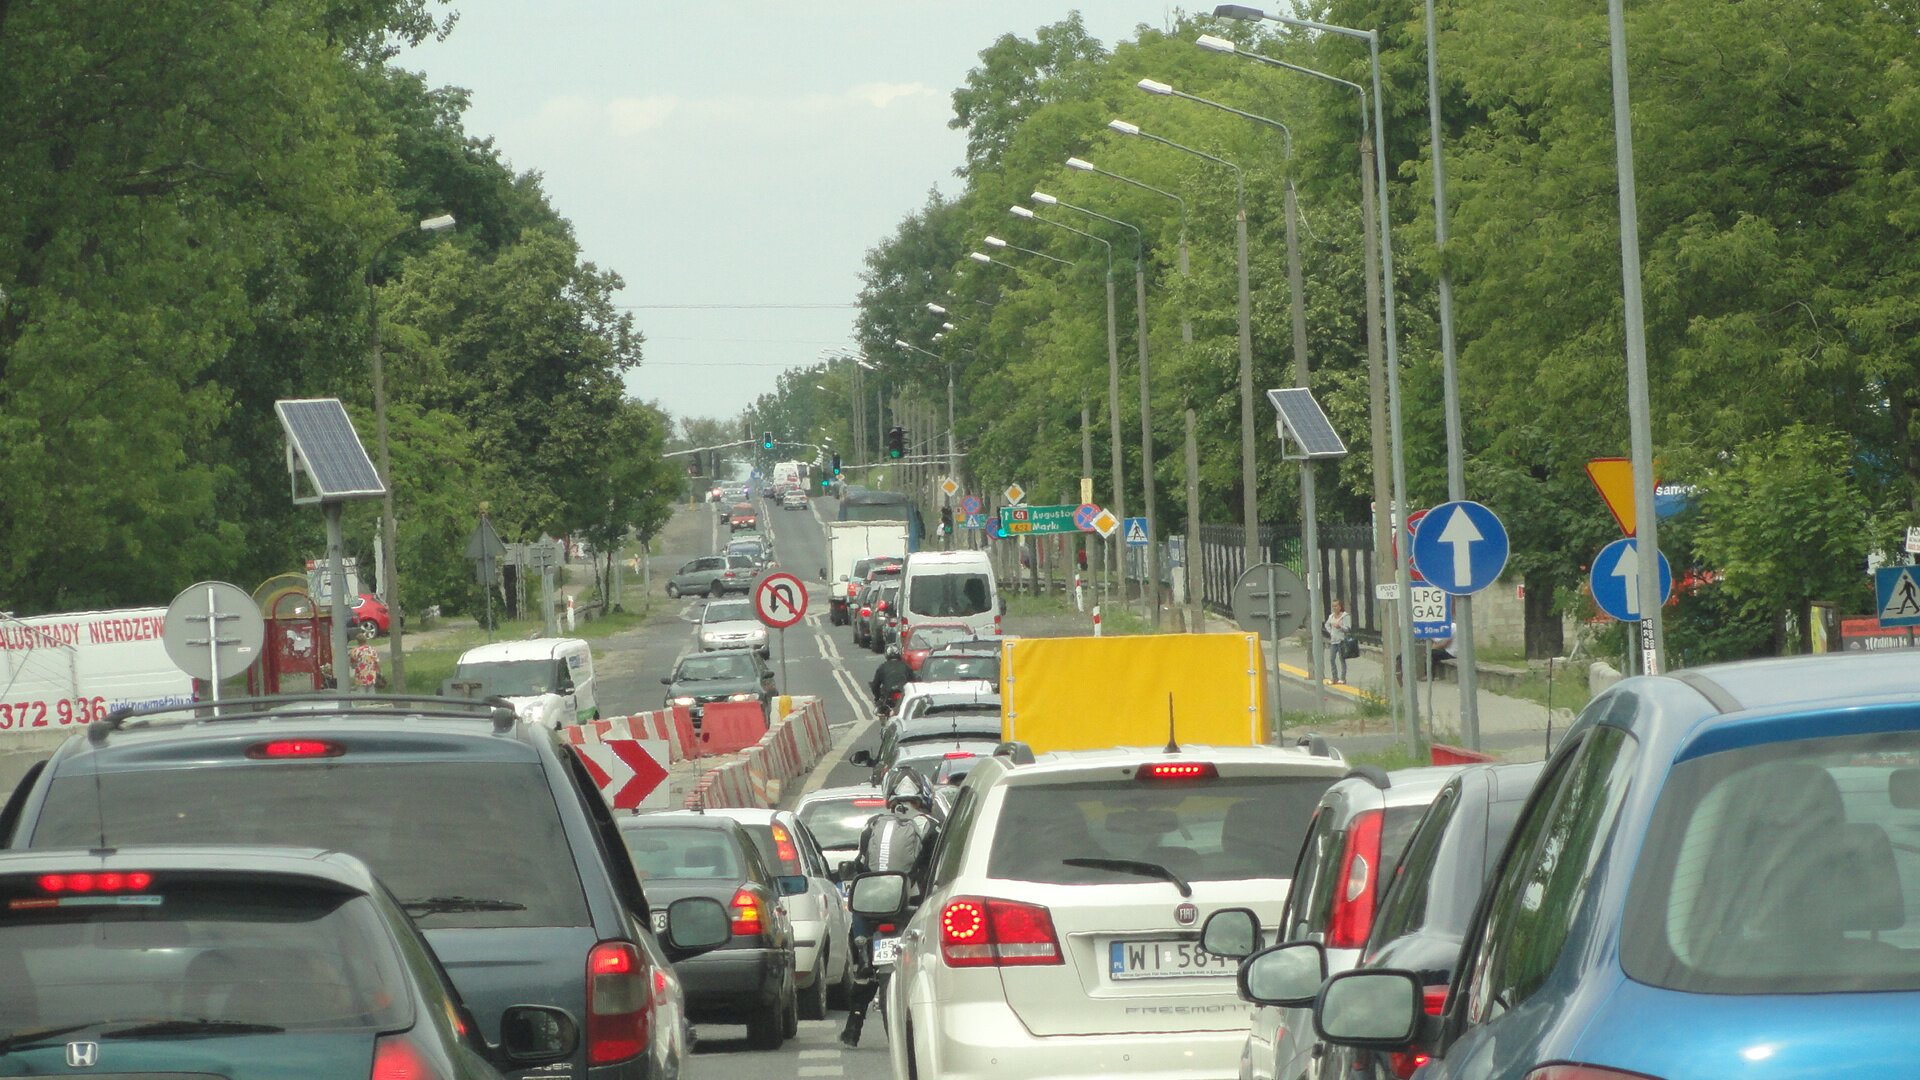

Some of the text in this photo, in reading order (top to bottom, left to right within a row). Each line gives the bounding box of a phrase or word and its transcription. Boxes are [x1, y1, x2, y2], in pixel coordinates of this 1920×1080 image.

[1032, 521, 1060, 531] Marki
[1413, 590, 1442, 603] LPG
[1412, 605, 1443, 618] GAZ
[0, 696, 108, 730] 372 936
[1180, 908, 1194, 920] FIAT
[1125, 1004, 1248, 1014] FREEMONT
